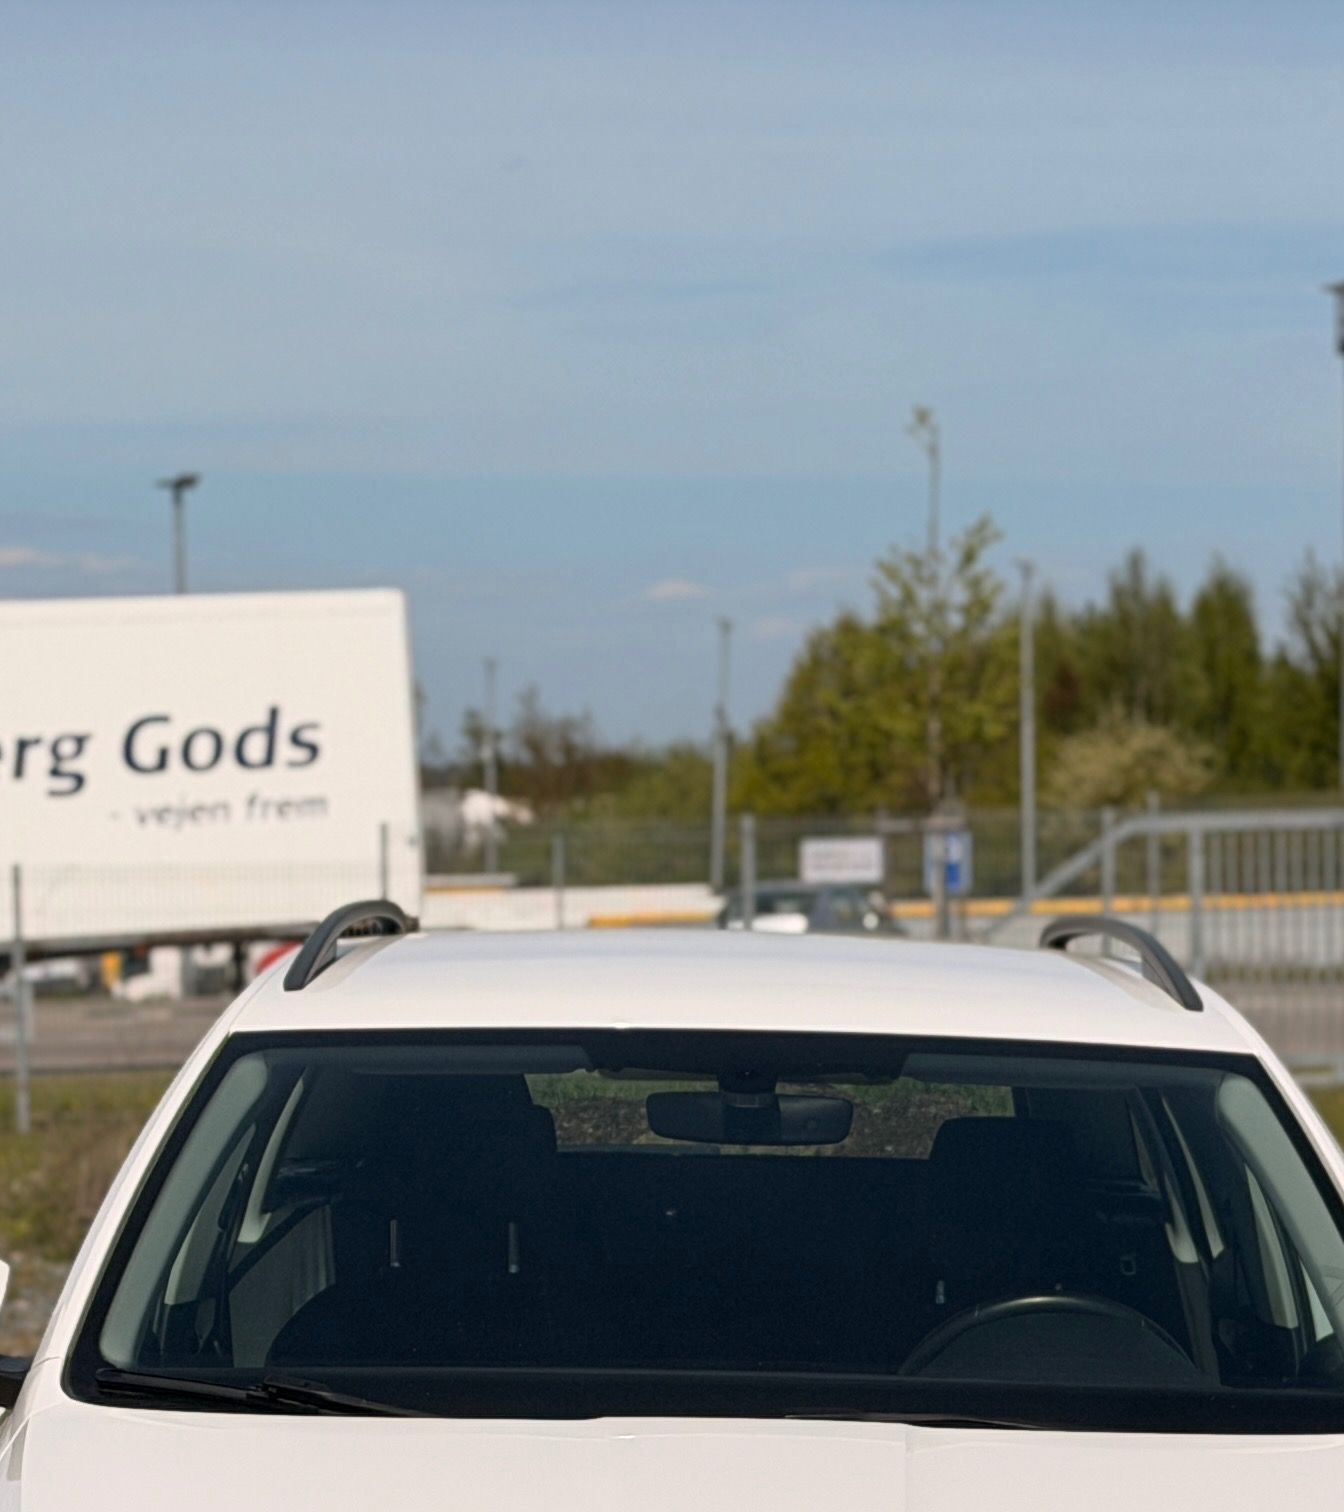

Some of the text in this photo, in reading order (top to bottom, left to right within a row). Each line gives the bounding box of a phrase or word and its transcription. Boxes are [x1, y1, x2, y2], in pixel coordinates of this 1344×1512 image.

[120, 704, 322, 777] Gods
[136, 800, 230, 830] vejen
[246, 793, 328, 822] frem
